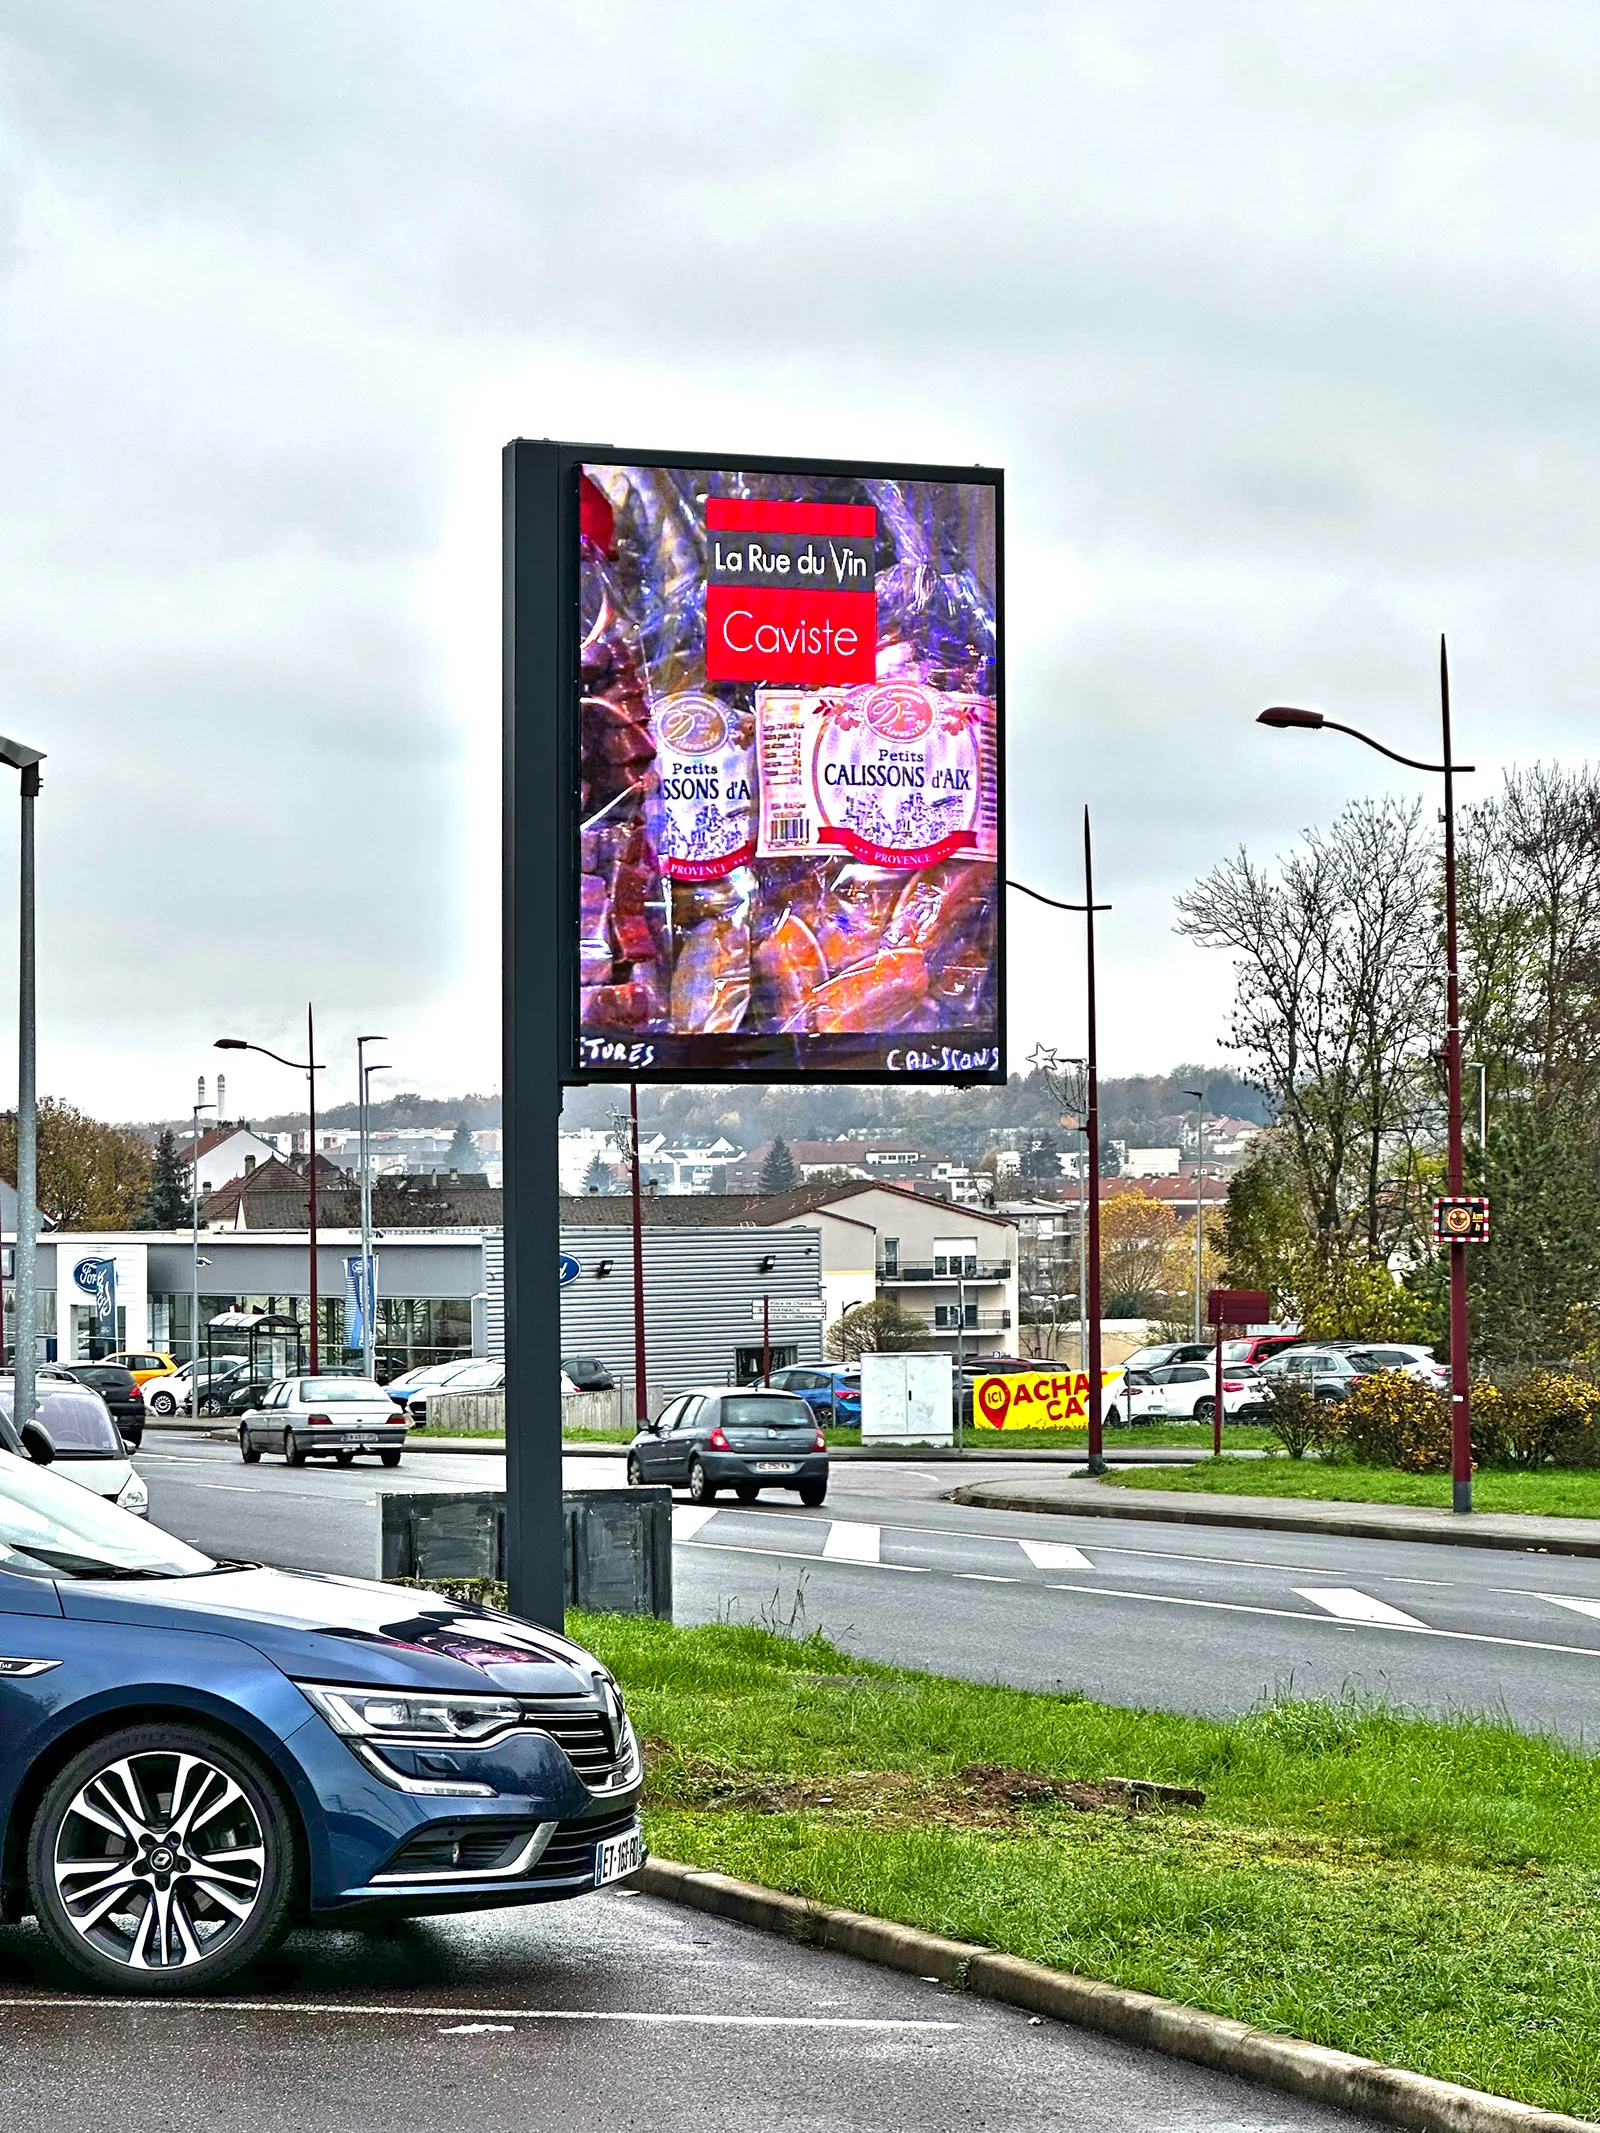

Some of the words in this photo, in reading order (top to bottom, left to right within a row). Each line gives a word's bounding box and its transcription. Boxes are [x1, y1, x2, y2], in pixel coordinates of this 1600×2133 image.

[714, 541, 743, 572] La
[748, 543, 792, 574] Rue
[797, 544, 826, 575] du
[828, 540, 867, 584] Vin
[723, 609, 858, 657] Caviste
[878, 748, 925, 763] Petits
[672, 762, 719, 775] Petits
[824, 763, 926, 789] CALISSONS
[931, 768, 972, 791] d'AIX
[873, 851, 933, 865] PROVENCE
[987, 1390, 1003, 1404] ICI
[1046, 1391, 1090, 1421] CA
